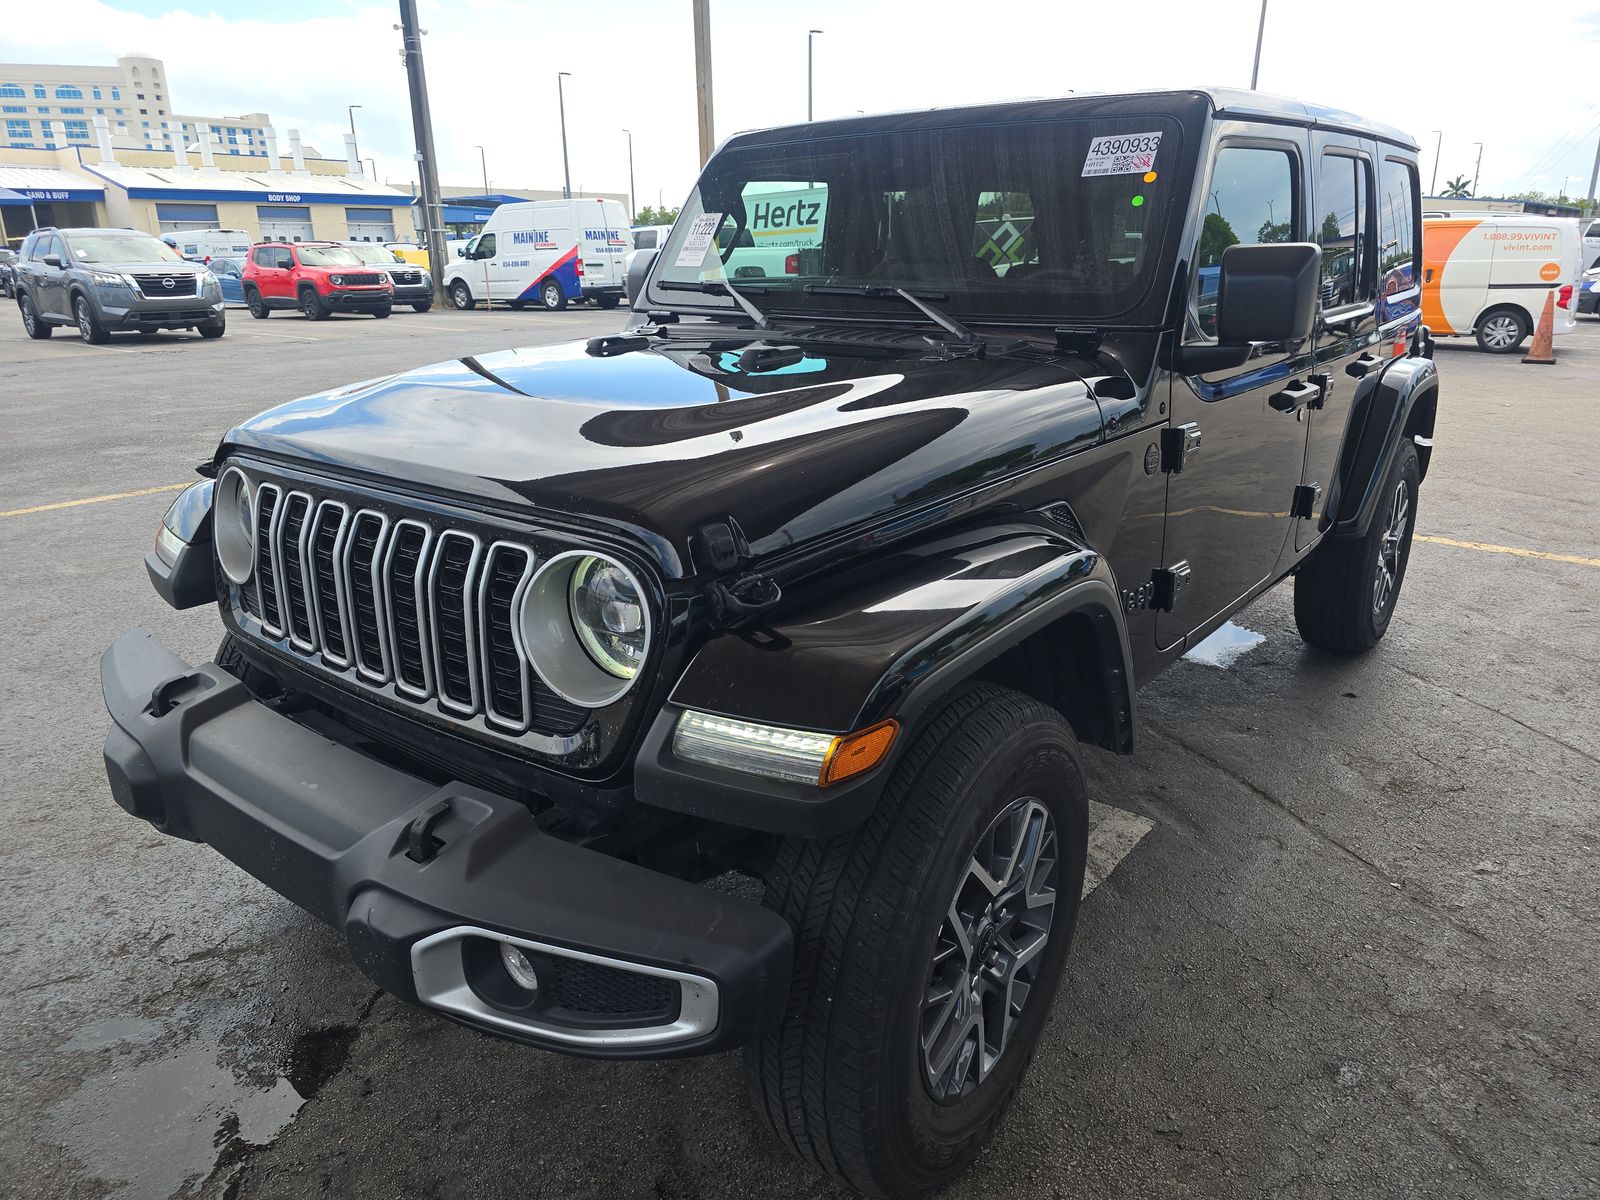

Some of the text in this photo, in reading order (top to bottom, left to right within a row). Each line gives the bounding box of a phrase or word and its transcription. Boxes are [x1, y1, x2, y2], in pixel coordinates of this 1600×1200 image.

[1092, 136, 1160, 155] 4390933
[26, 191, 70, 199] SAND & BUFF
[268, 194, 301, 202] BODY SHOP
[753, 200, 820, 229] Hertz
[1483, 232, 1558, 241] 1.888.99.VIVINT
[1503, 243, 1552, 251] vivint.com
